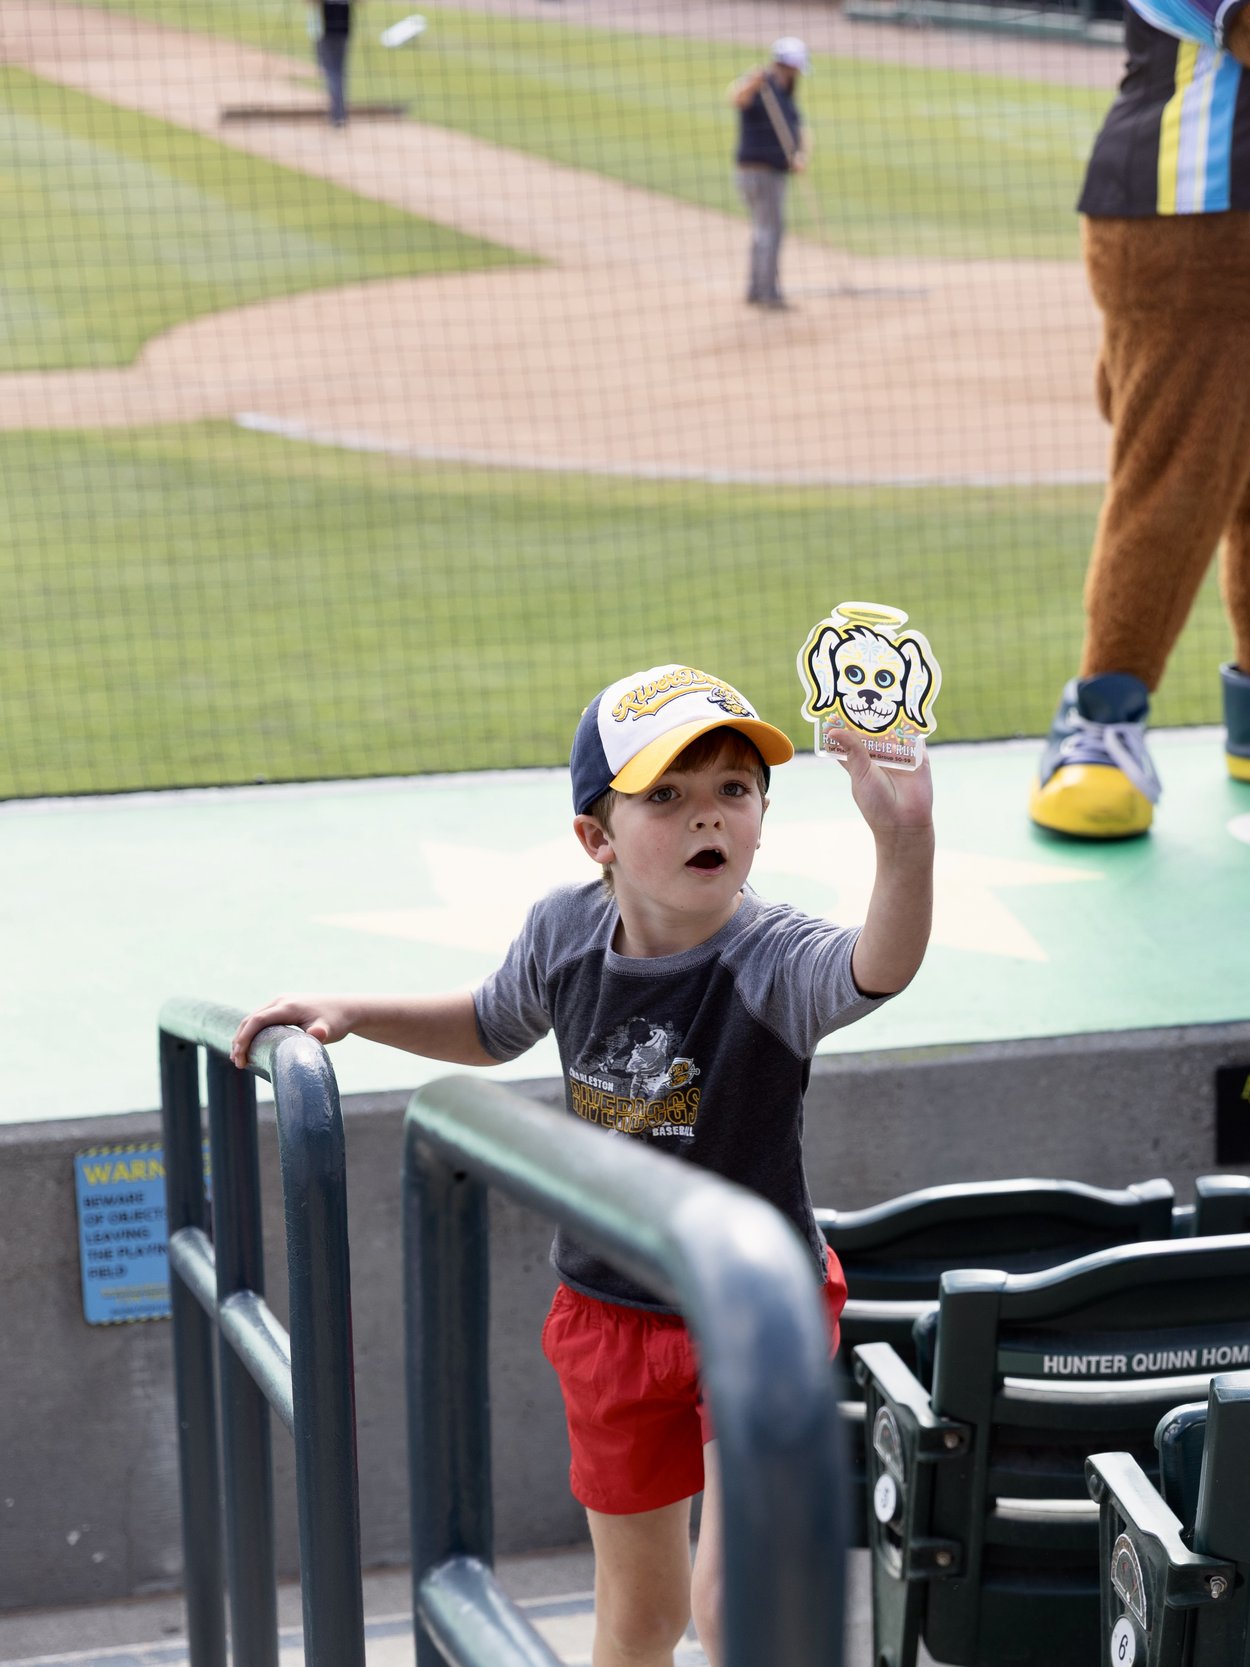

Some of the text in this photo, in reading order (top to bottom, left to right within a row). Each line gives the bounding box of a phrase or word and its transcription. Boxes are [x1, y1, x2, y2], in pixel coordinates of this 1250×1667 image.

[568, 1066, 614, 1092] CHARLESTON
[570, 1080, 701, 1133] RIVERDOGS
[652, 1125, 695, 1138] BASEBALL
[1043, 1355, 1128, 1374] HUNTER
[1132, 1350, 1197, 1373] QUINN
[1118, 1634, 1129, 1661] 6
